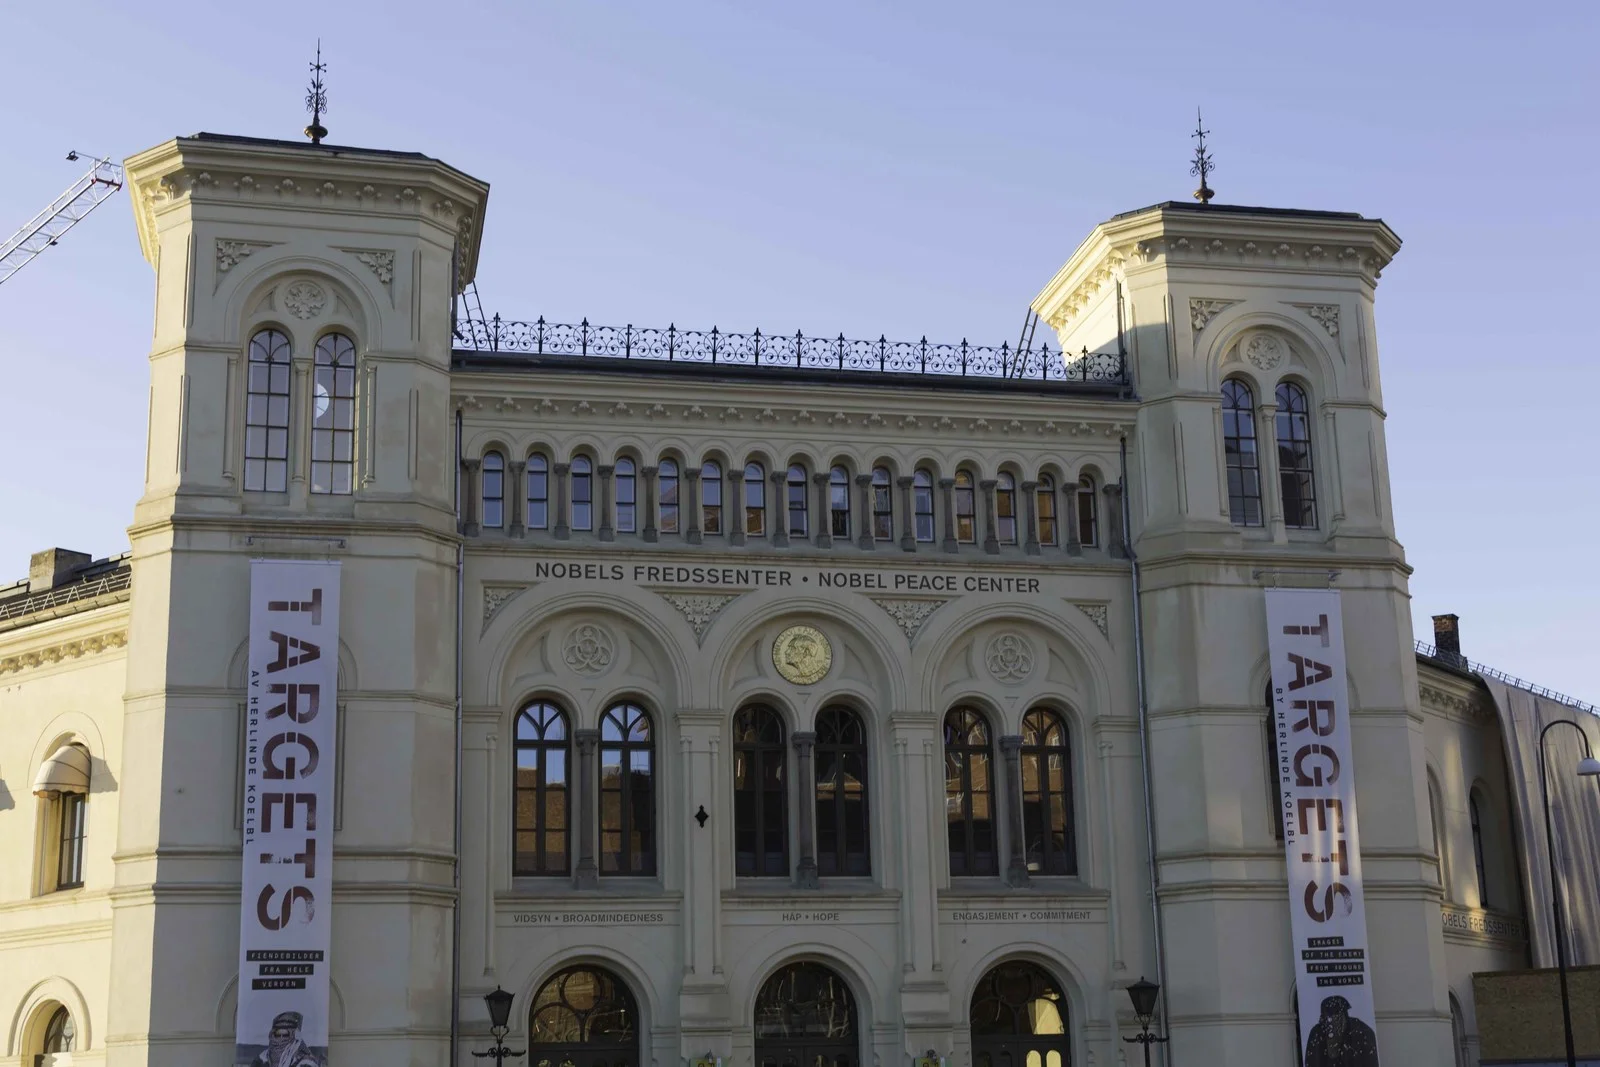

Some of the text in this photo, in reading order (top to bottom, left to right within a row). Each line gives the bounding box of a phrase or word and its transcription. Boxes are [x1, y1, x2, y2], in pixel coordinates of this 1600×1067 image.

[535, 562, 1040, 593] NOBELS FREDSSENTER NOBEL PEACE CENTER
[246, 670, 260, 845] AV HERLINDE KOELBL
[257, 588, 322, 931] TARGETS
[1275, 688, 1295, 845] BY HERLINDE KOELBL
[1283, 614, 1353, 923] TARGETS
[514, 913, 664, 923] VIDSYN BROADMINDEDNESS
[812, 912, 840, 921] HOPE
[952, 911, 1091, 921] ENGASJEMENT COMMITMENT
[1312, 938, 1341, 946] IMAGES
[251, 952, 320, 960] FIENDEBILDER
[262, 980, 296, 988] VERDEN
